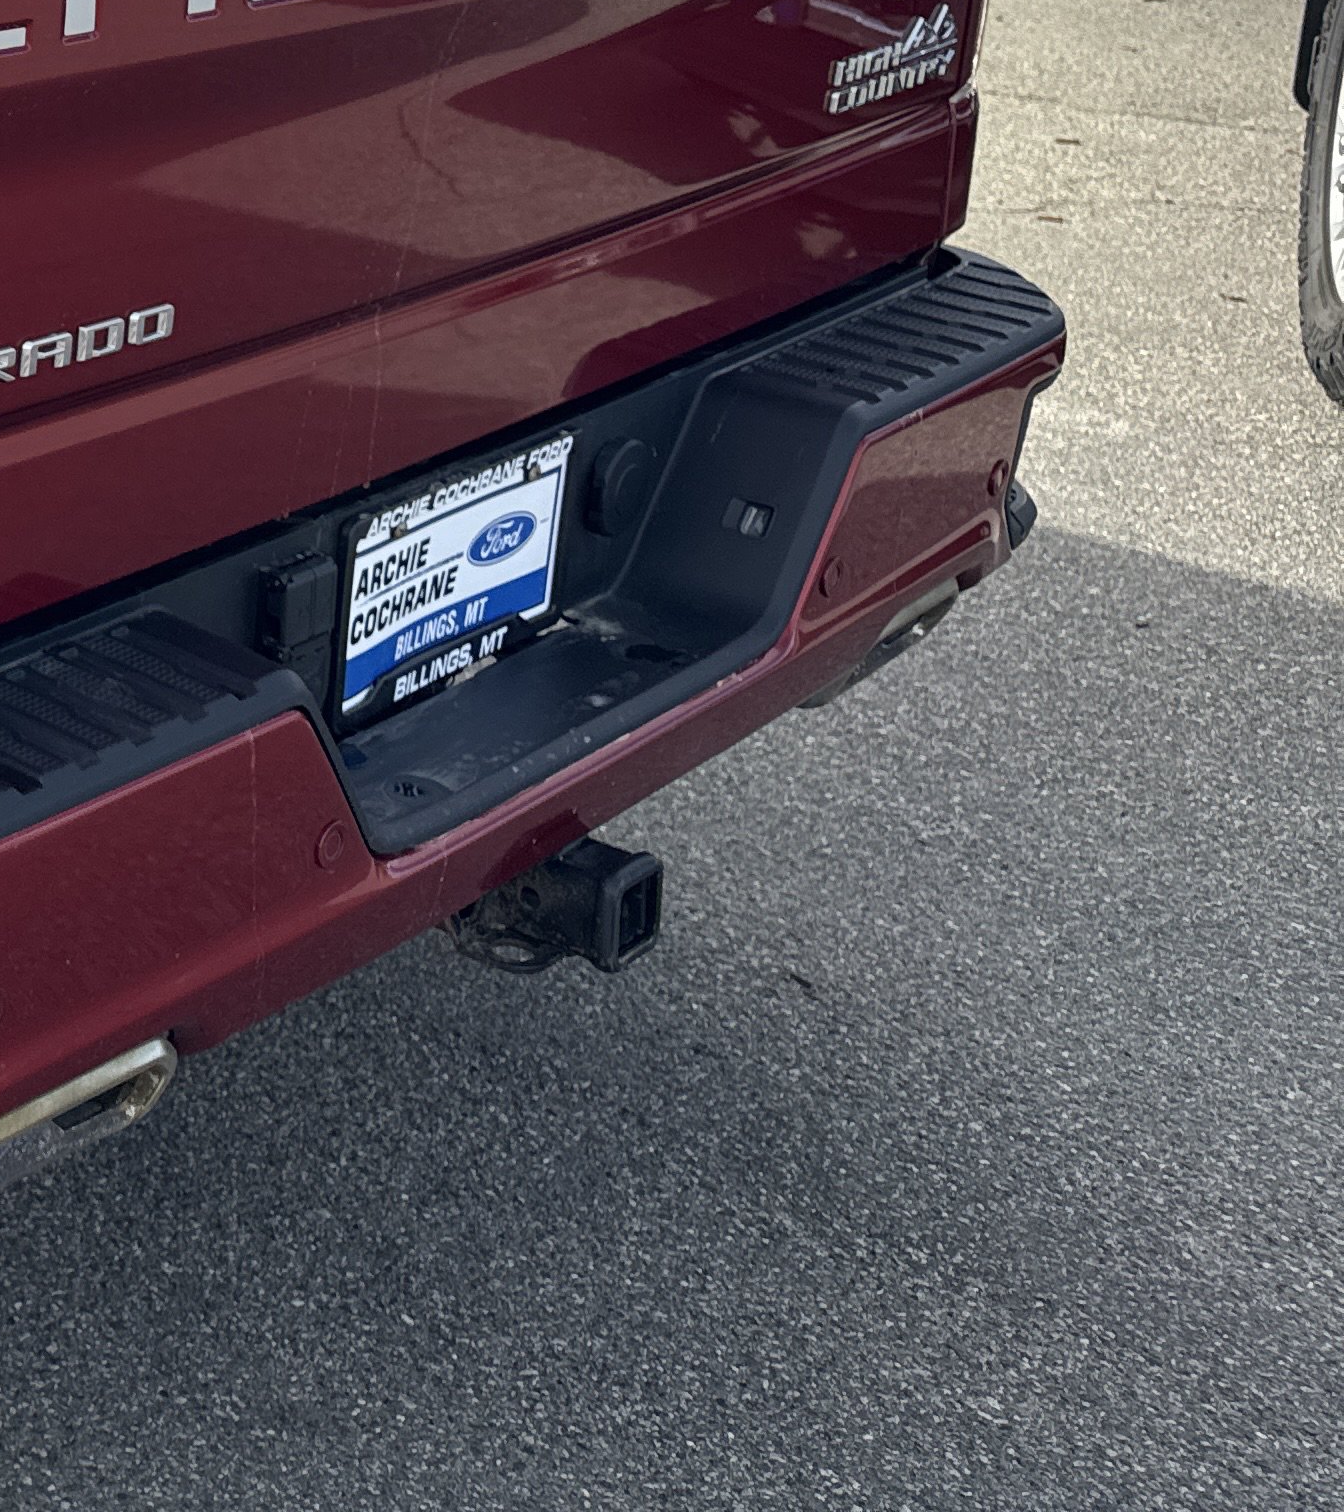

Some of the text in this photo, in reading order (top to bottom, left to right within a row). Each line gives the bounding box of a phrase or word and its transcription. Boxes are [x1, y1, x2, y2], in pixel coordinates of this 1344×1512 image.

[827, 48, 957, 115] COUNTRY
[831, 41, 904, 87] HIGH
[366, 435, 574, 540] ARCHIE COCHRANE FORD
[354, 536, 431, 601] ARCHIE
[480, 522, 522, 559] Ford
[351, 565, 459, 645] COCHRANE
[394, 596, 489, 662] BILLINGS, MT
[393, 625, 508, 703] BILLINGS, MT
